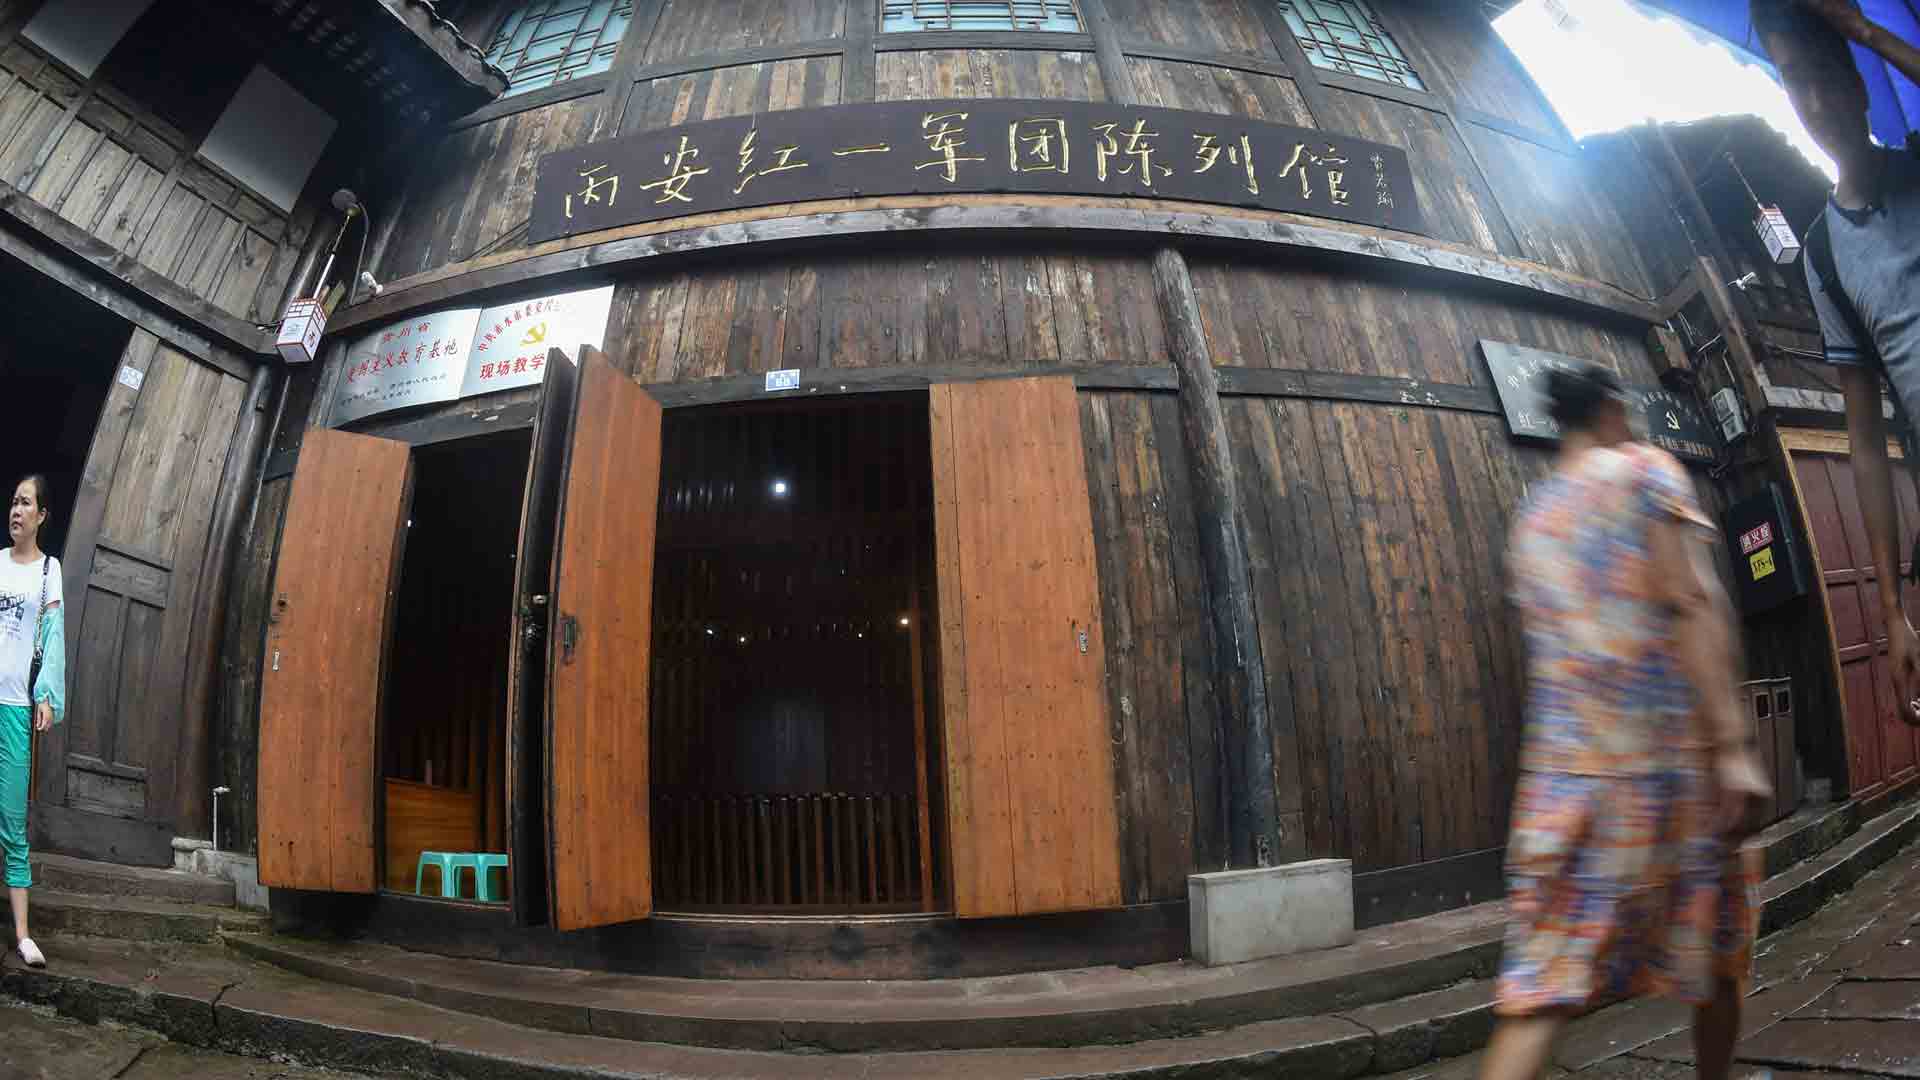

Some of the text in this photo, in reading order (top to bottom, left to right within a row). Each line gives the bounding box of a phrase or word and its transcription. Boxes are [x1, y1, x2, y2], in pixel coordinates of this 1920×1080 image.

[565, 111, 1350, 218] 丙安红一军团陈列馆
